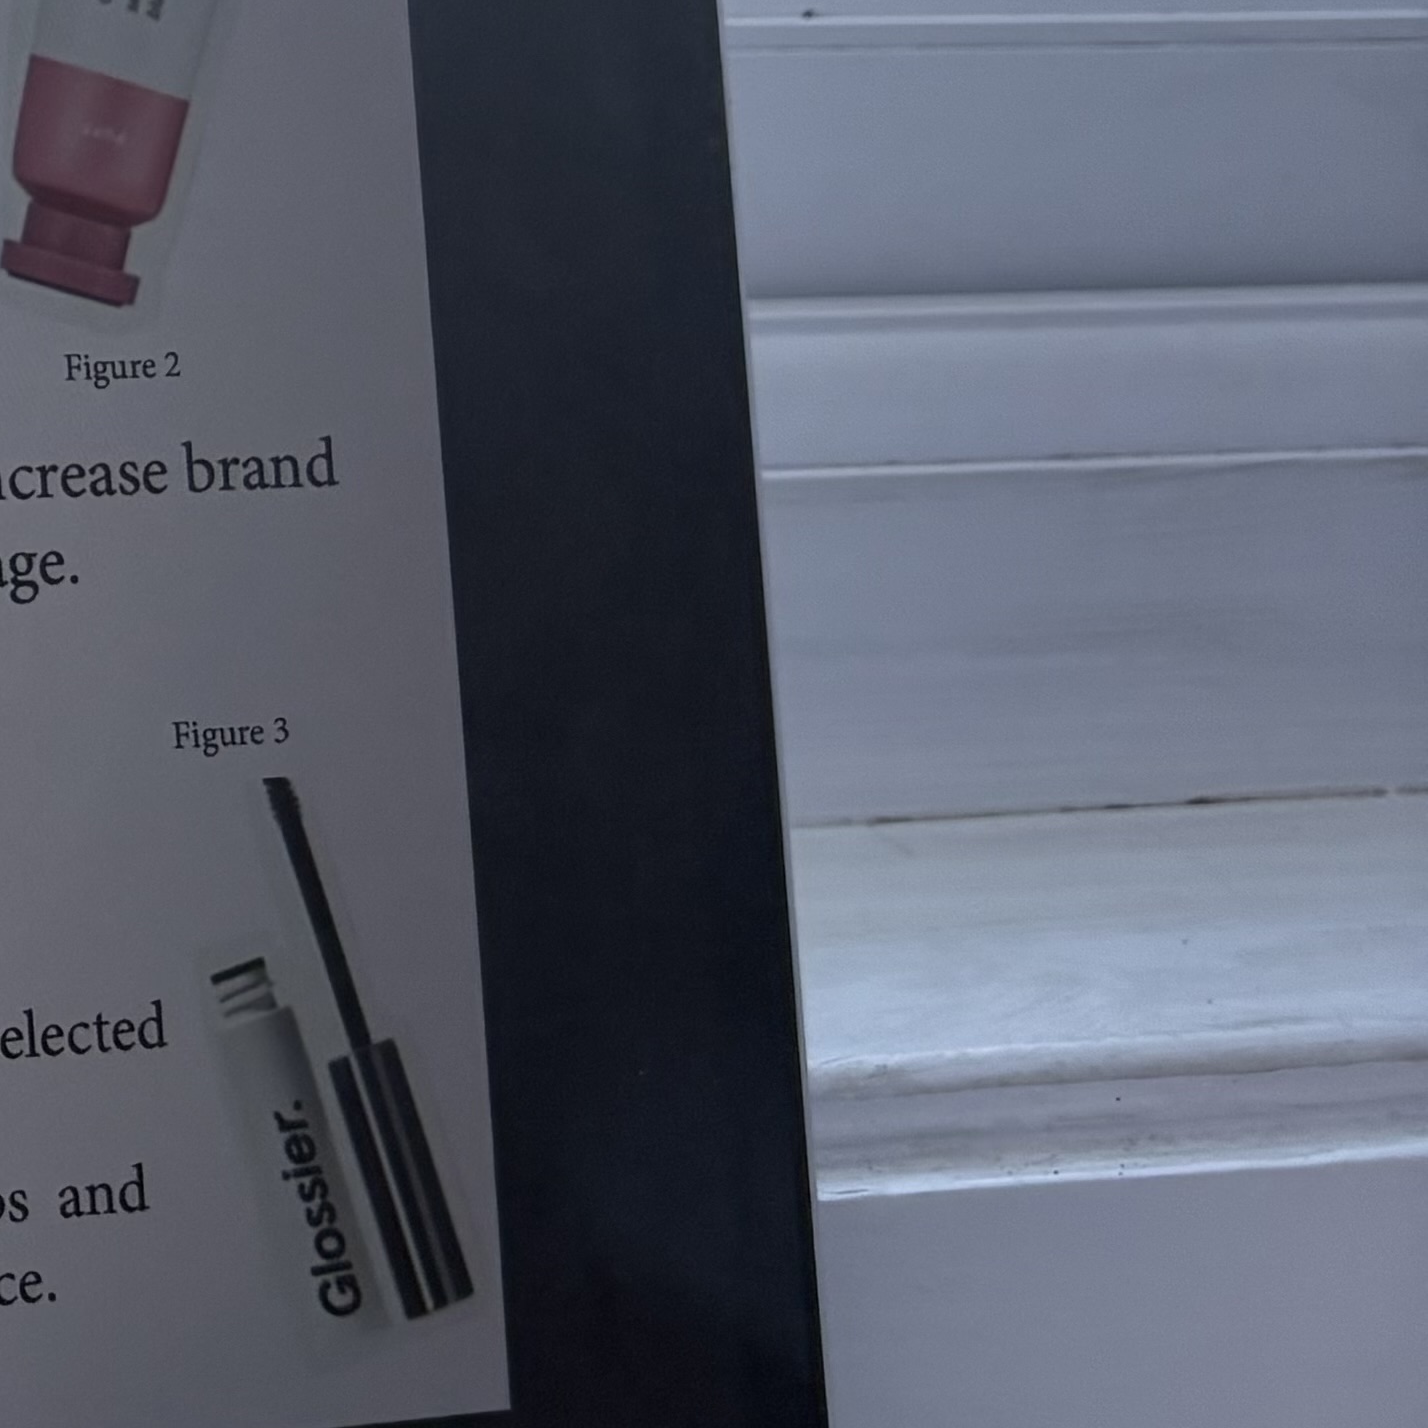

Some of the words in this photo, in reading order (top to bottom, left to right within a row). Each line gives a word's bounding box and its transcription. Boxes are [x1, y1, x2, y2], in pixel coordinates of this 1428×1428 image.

[65, 357, 156, 389] Figure
[165, 352, 180, 378] 2
[181, 436, 339, 493] brand
[173, 722, 264, 757] Figure
[275, 718, 289, 744] 3
[272, 1098, 364, 1319] Glossier.
